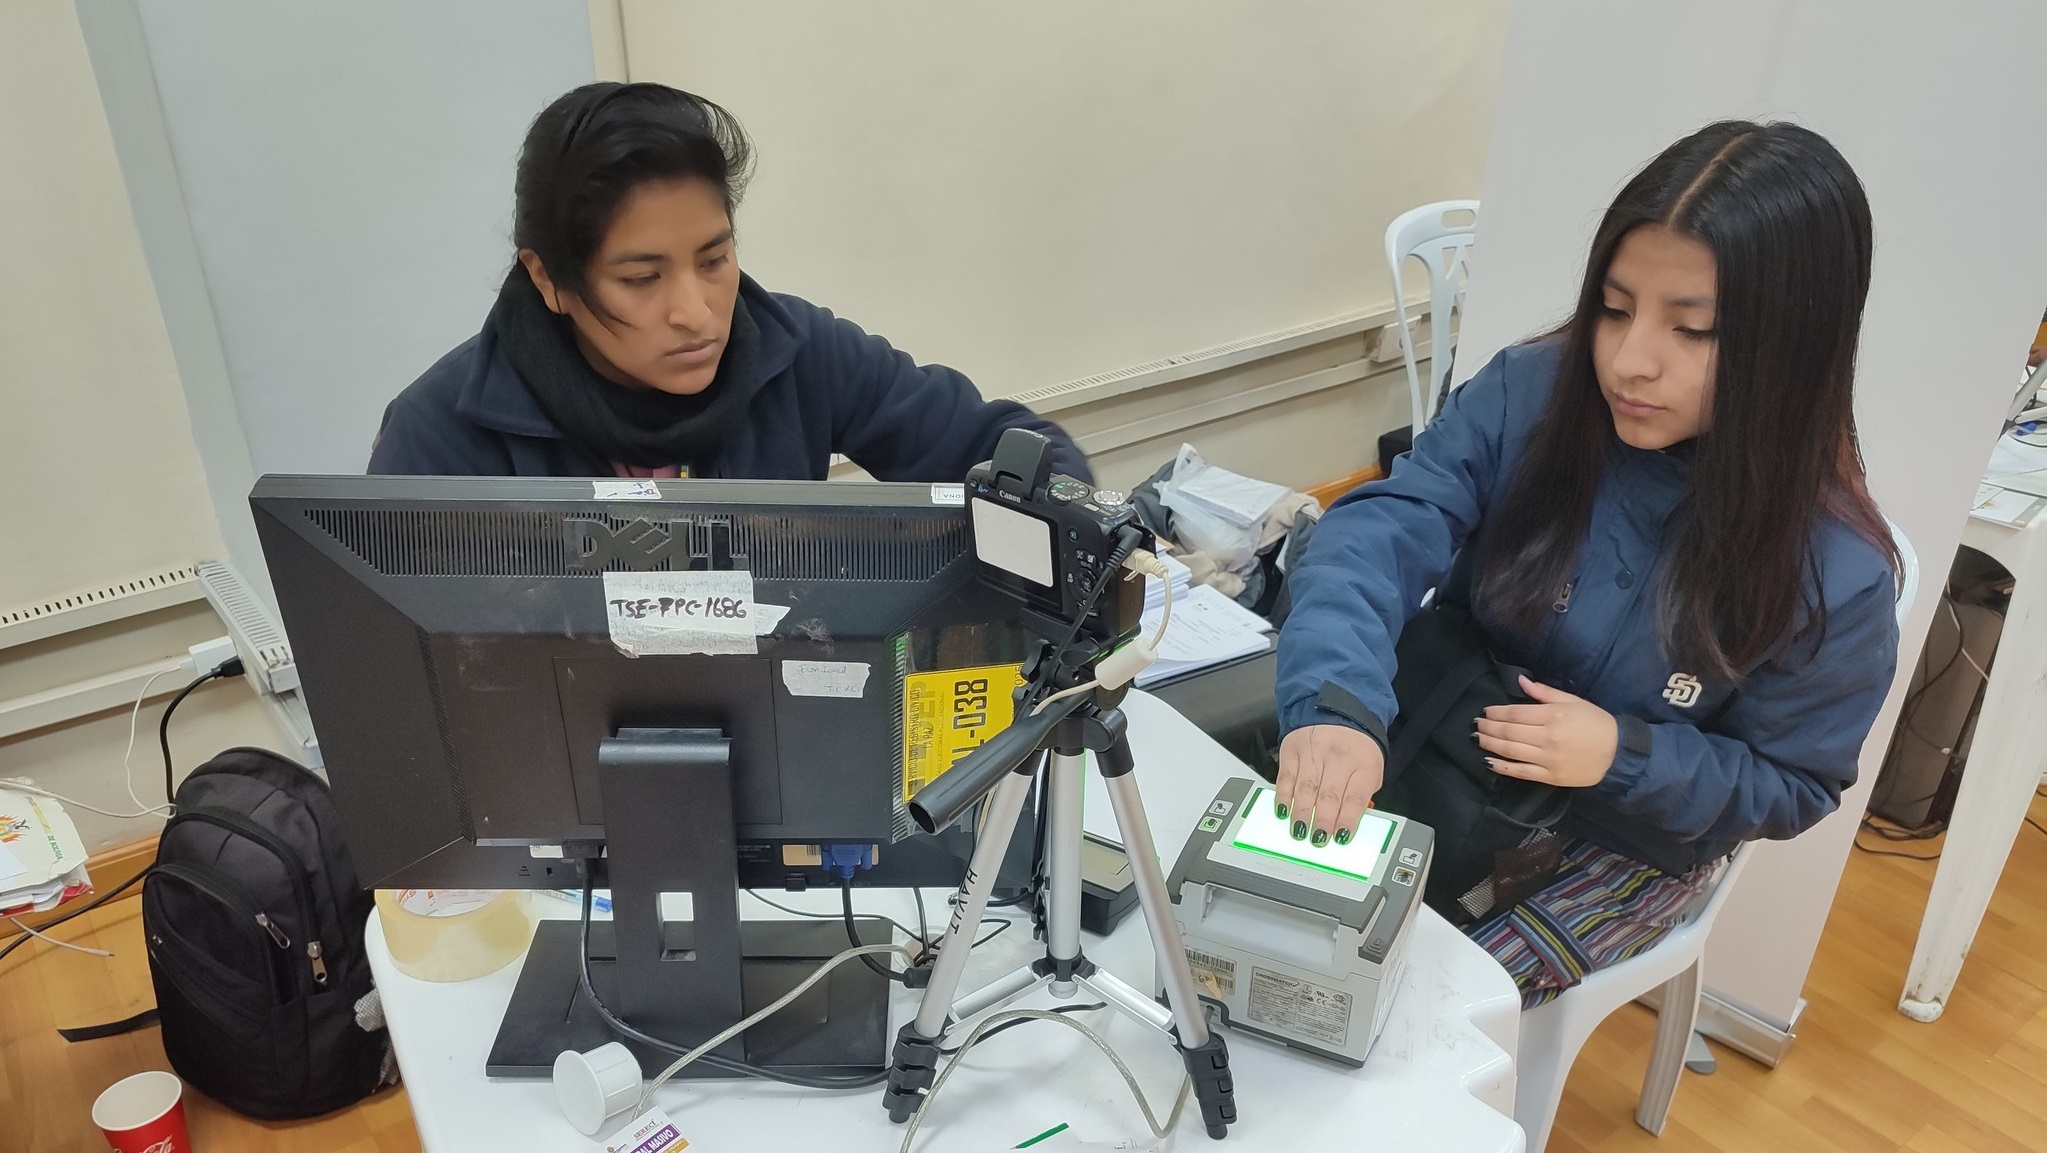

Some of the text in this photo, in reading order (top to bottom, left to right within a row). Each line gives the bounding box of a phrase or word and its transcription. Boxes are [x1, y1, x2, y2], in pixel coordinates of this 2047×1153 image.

[999, 489, 1021, 503] Canon
[563, 517, 749, 571] DELL
[924, 724, 933, 739] PAZ
[952, 679, 988, 765] L-038
[950, 868, 978, 935] HAVIT
[648, 1128, 674, 1150] MASIVO
